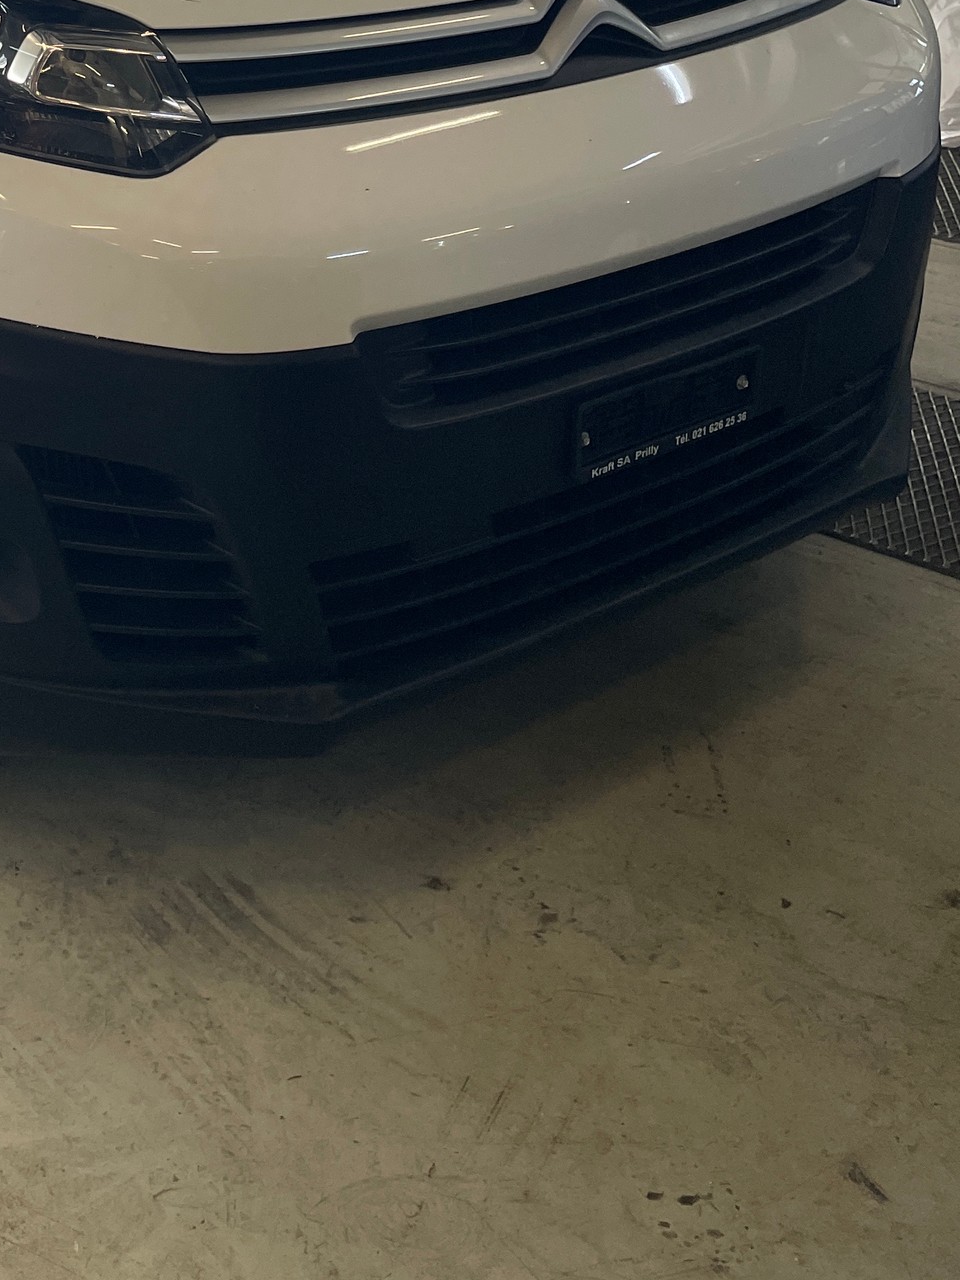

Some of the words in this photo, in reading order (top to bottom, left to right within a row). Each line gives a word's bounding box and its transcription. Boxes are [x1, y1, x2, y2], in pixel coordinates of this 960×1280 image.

[591, 461, 615, 479] Kraft
[616, 455, 631, 468] SA
[635, 444, 659, 460] Prilly
[692, 426, 707, 439] 021
